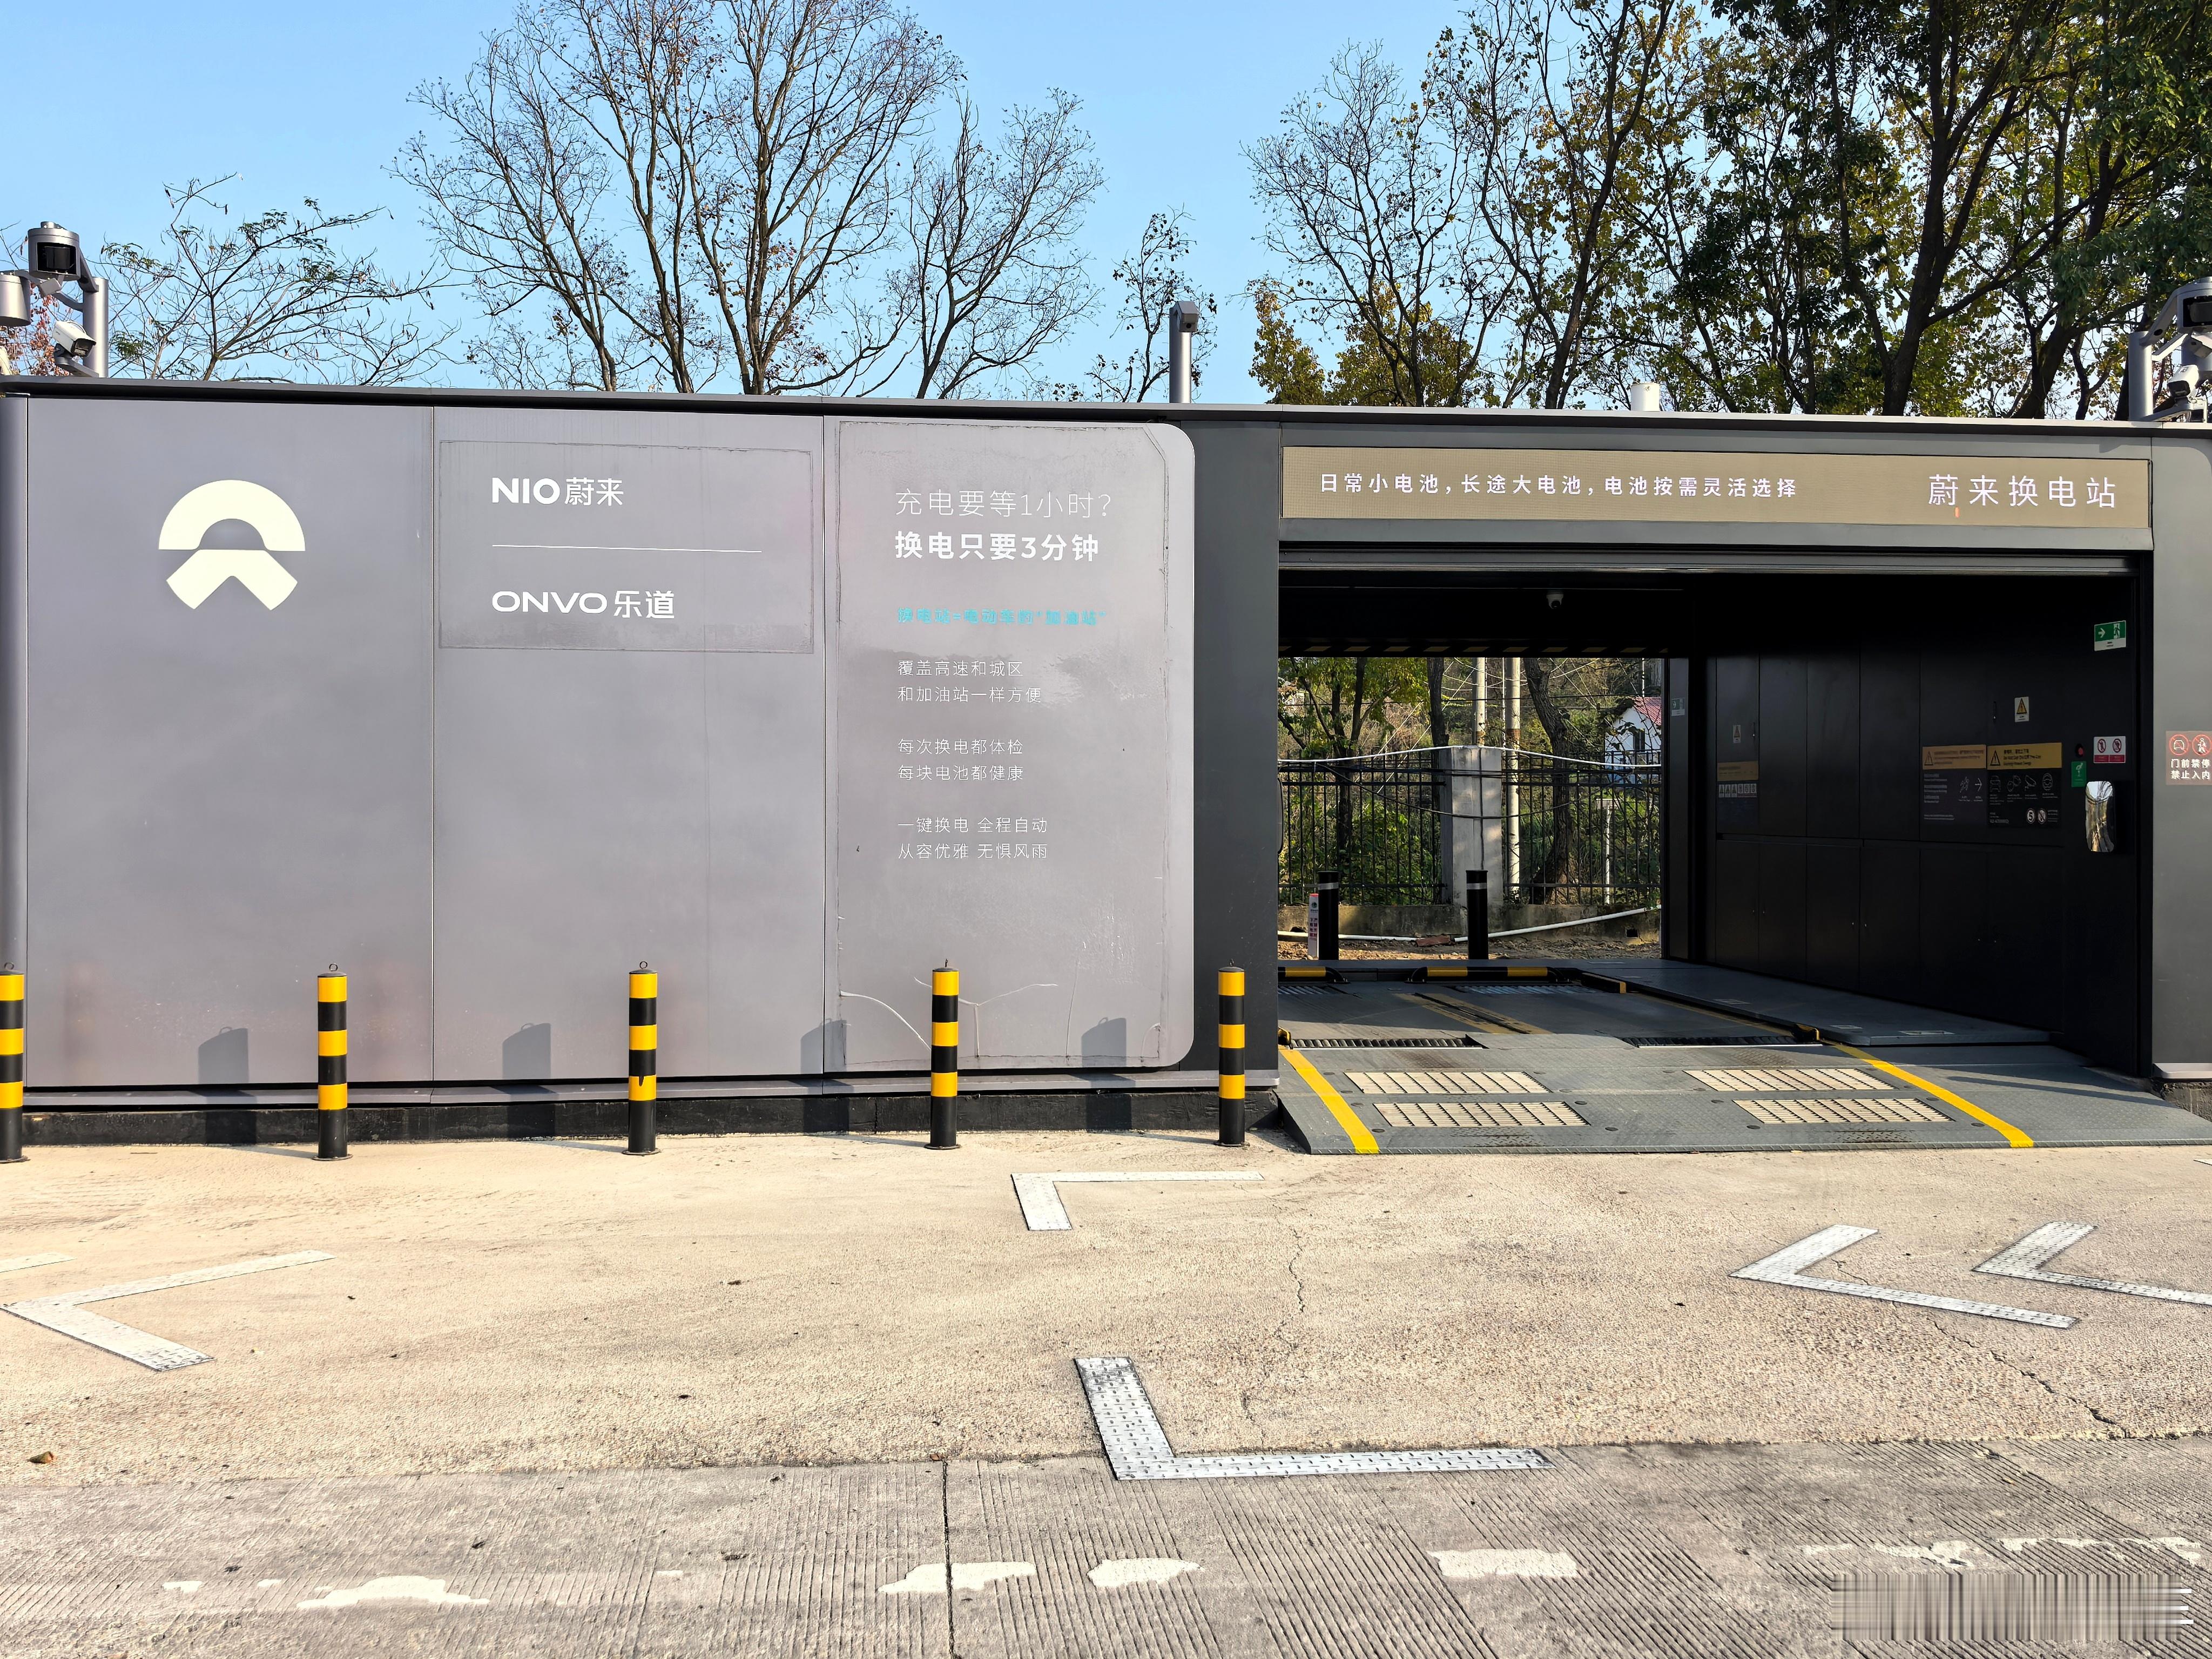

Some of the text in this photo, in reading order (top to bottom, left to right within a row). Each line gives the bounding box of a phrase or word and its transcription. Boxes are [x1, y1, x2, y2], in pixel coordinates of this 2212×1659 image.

[1928, 474, 2116, 508] 蔚来换电站
[895, 530, 1098, 562] 换电只要3分钟
[898, 659, 1024, 677] 覆盖高速和城区
[898, 685, 1042, 704] 和加油站一样方便
[898, 738, 1024, 755] 每次换电都体检
[2170, 758, 2210, 768] 门前禁停
[898, 764, 1024, 781] 每块电池都健康
[2170, 770, 2210, 780] 禁止入内
[898, 817, 1048, 834] 一键换电 全程自动
[898, 842, 1048, 860] 从容优雅 无惧风雨
